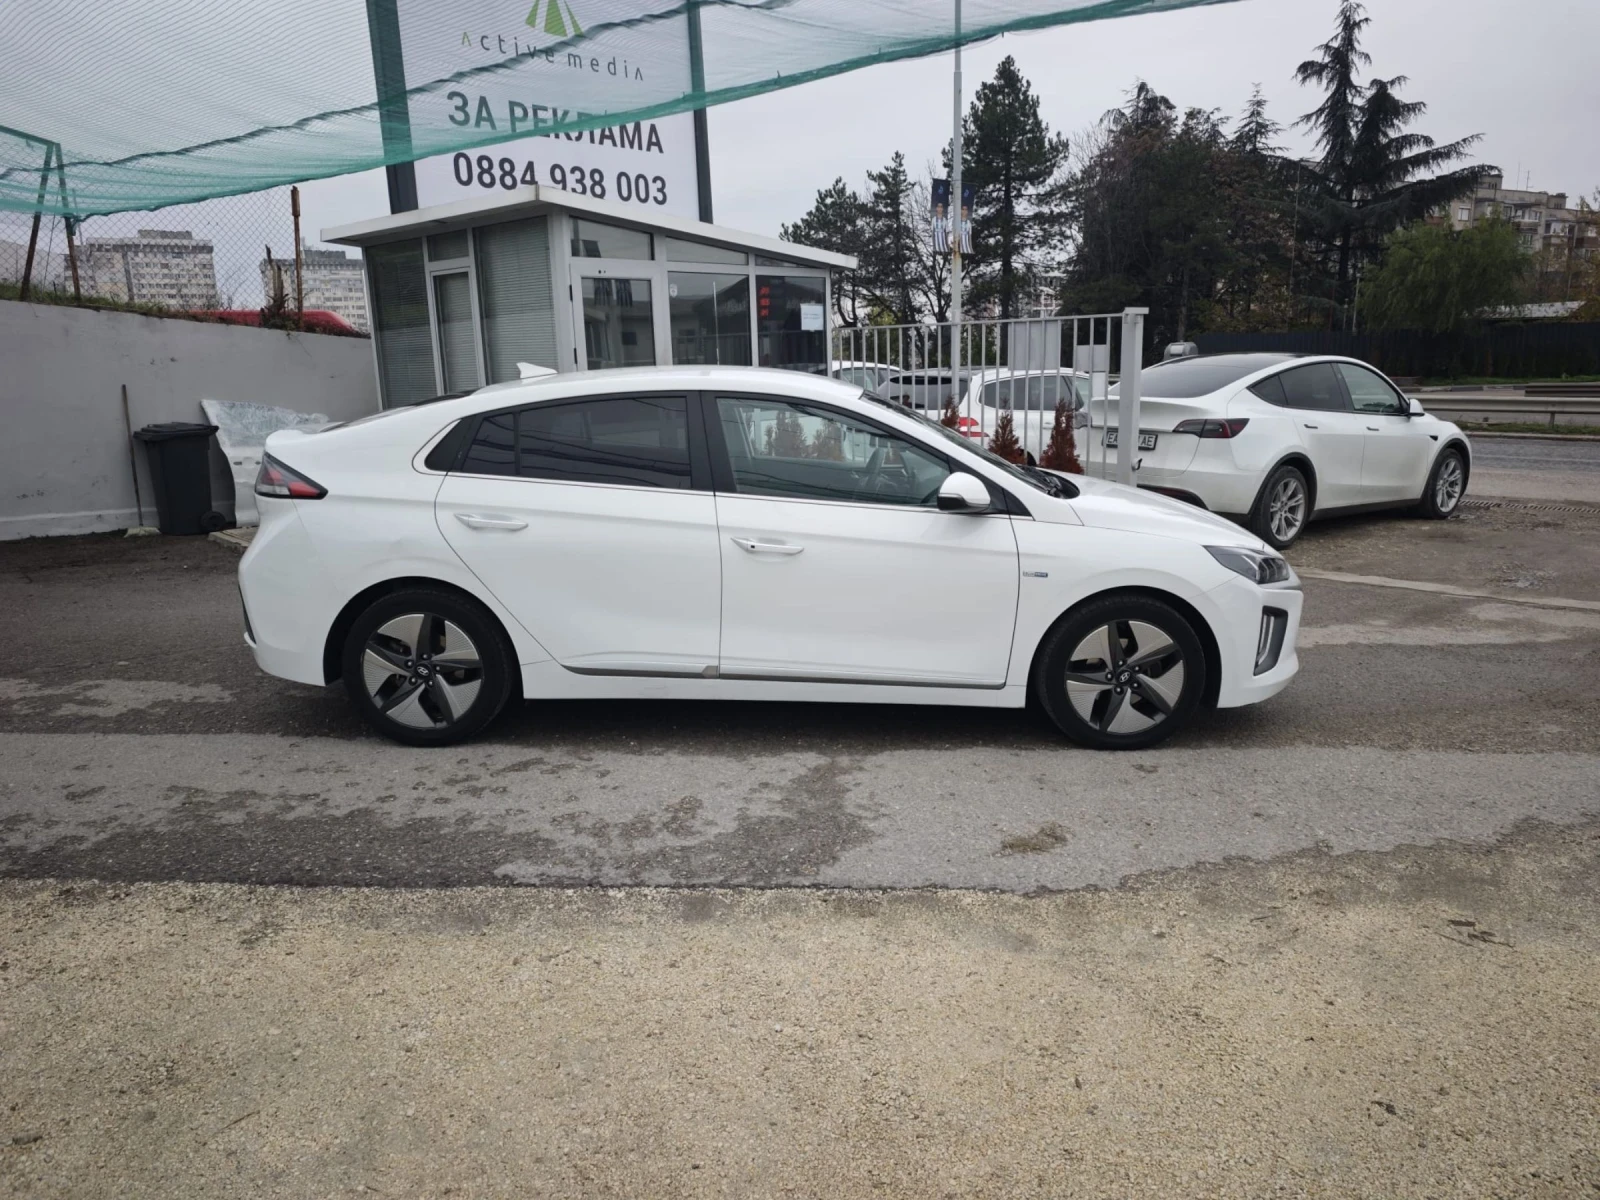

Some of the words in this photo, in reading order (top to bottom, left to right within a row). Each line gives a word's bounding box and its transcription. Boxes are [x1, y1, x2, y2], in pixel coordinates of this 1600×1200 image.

[447, 91, 497, 131] ЗА
[453, 152, 539, 191] 0884
[550, 163, 606, 200] 938
[616, 171, 668, 206] 003
